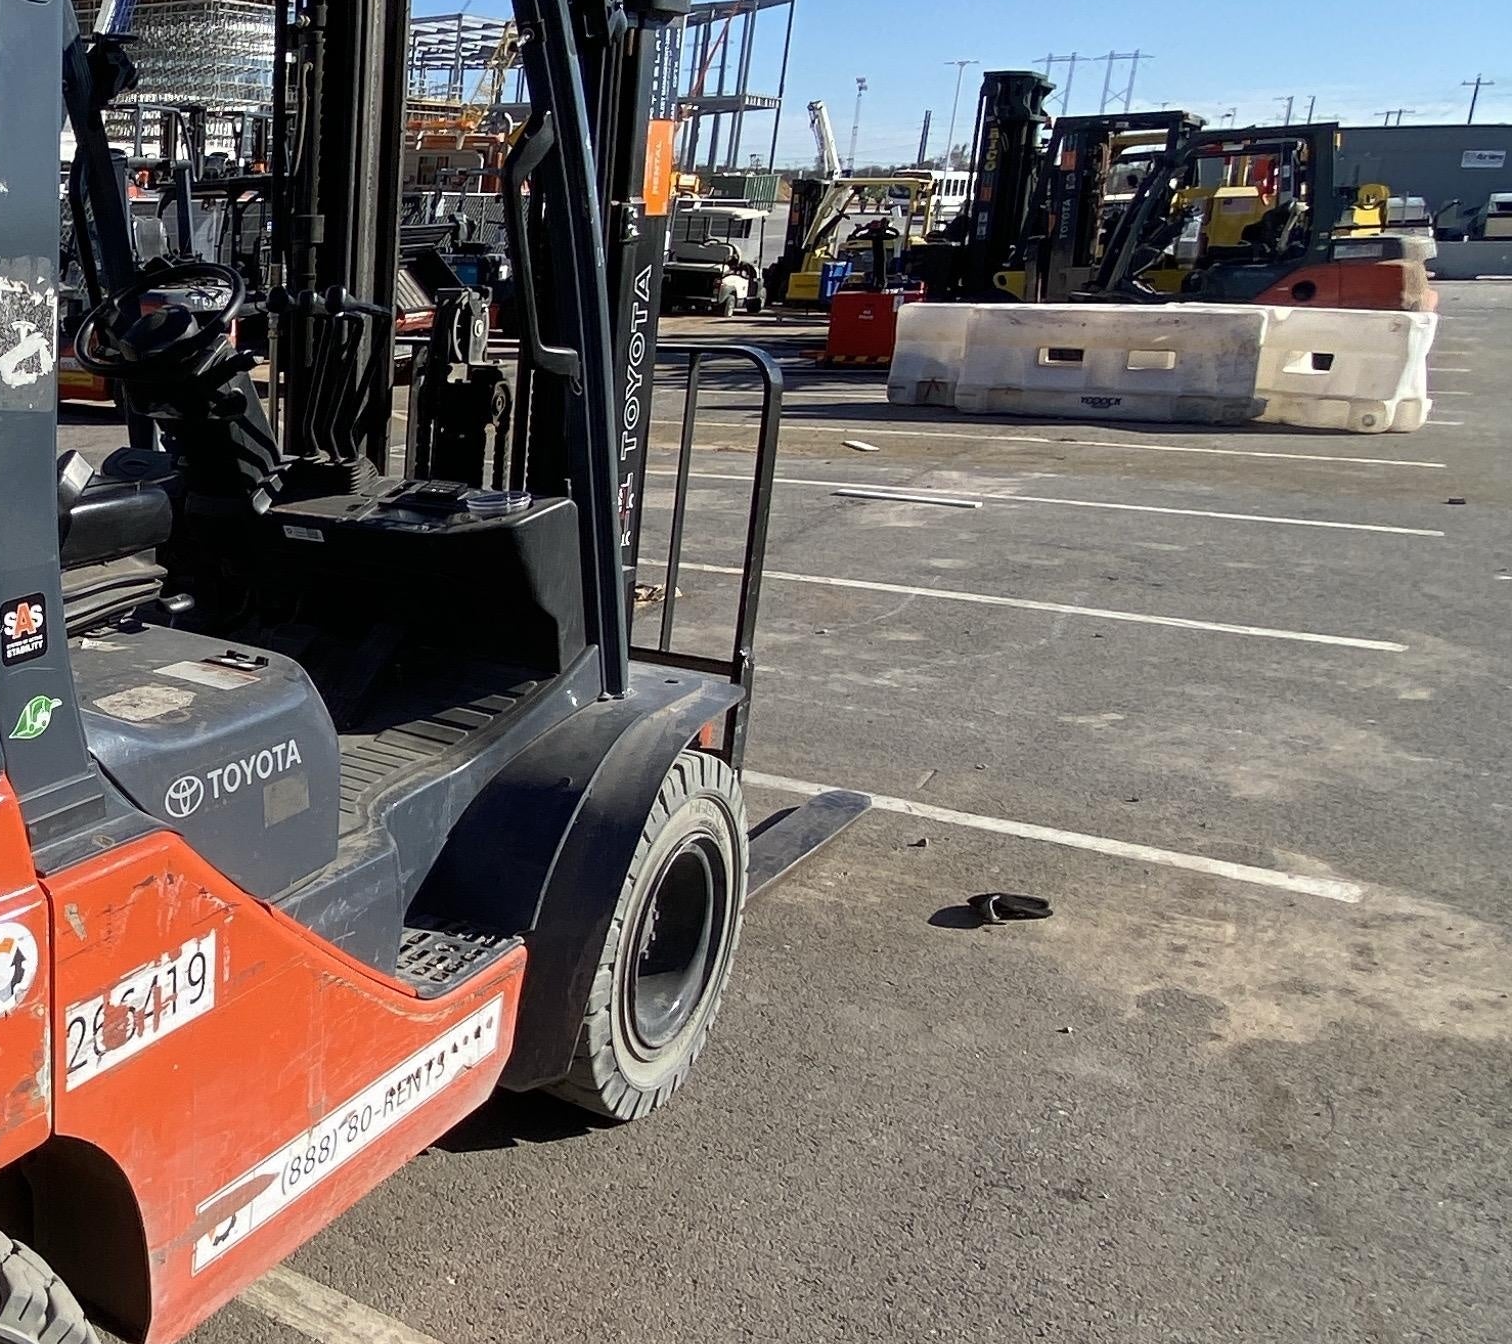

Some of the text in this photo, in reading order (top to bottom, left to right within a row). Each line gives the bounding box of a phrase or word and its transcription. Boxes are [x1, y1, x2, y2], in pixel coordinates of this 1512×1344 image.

[651, 141, 663, 195] RENTAL
[1058, 200, 1072, 240] TOYOTA
[621, 264, 652, 461] TOYOTA
[3, 602, 44, 640] SAS
[207, 739, 302, 800] TOYOTA
[280, 1127, 339, 1196] (888)
